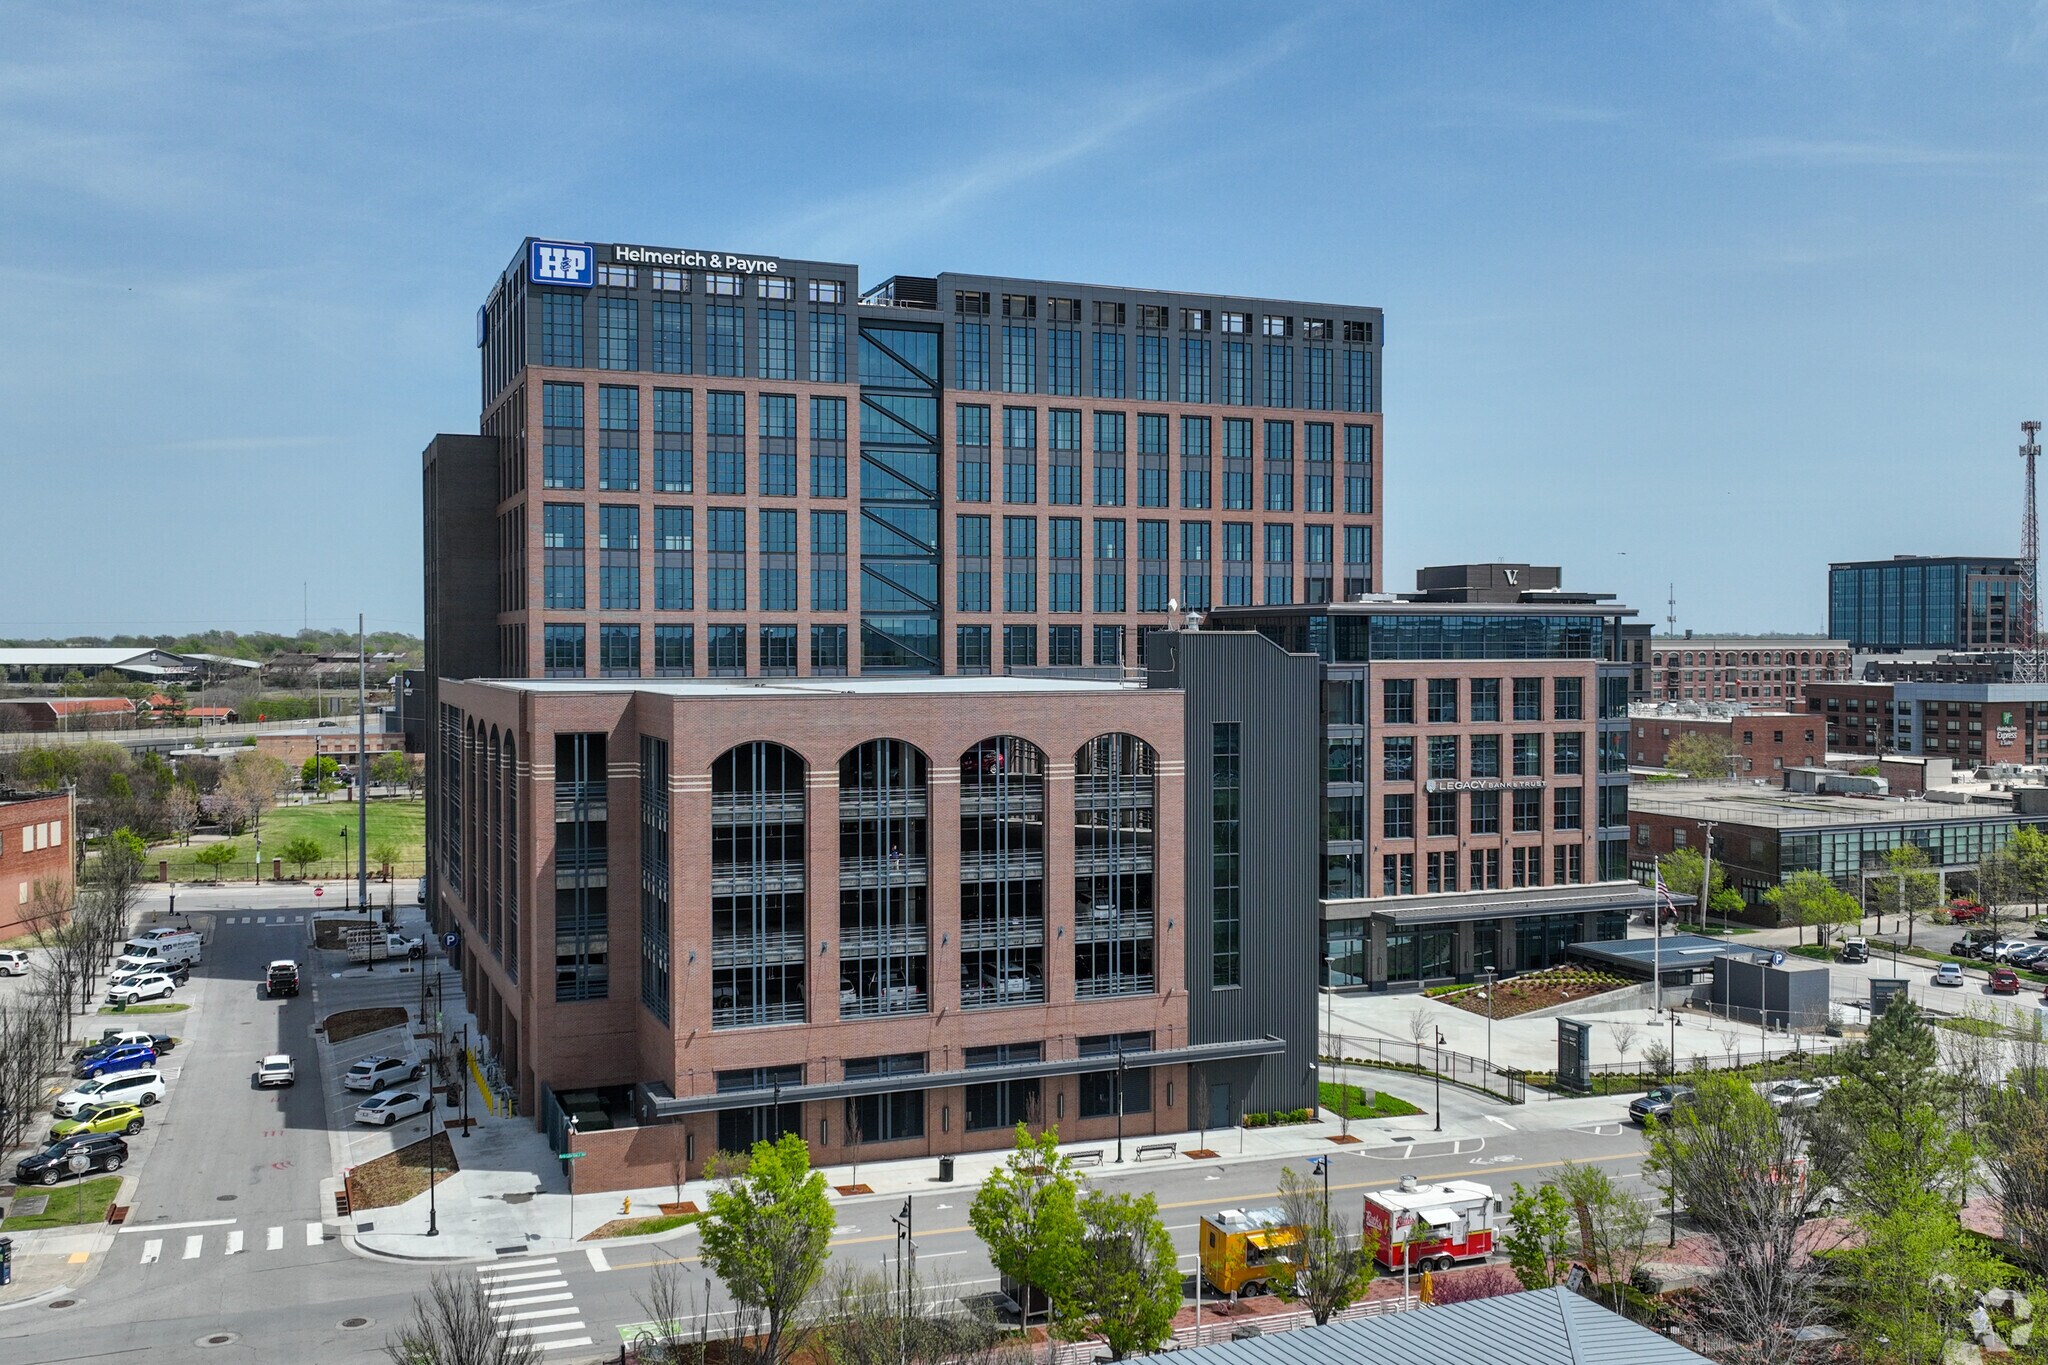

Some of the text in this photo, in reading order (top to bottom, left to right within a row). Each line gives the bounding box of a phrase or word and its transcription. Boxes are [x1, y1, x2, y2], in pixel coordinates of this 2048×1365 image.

[616, 246, 778, 274] Helmerich & Payne
[1439, 780, 1487, 791] LEGACY
[1519, 780, 1547, 788] TRUST
[446, 935, 456, 946] P
[1776, 954, 1783, 964] P
